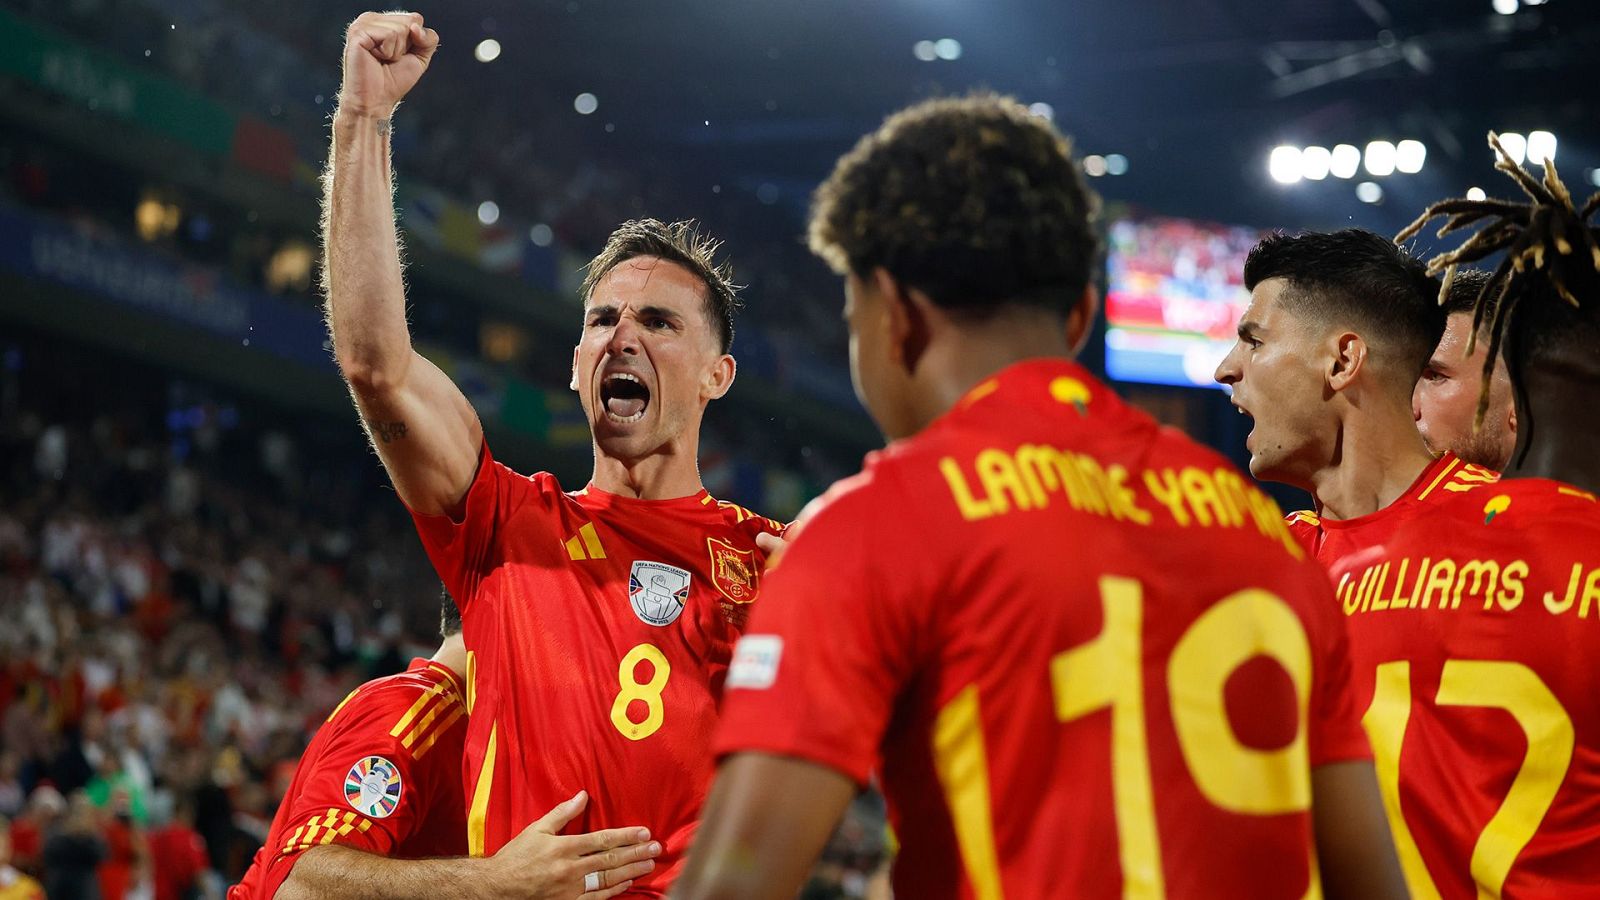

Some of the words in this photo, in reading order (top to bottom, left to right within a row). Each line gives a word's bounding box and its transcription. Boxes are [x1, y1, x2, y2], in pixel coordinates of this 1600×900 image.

[938, 443, 1152, 526] LAMINE
[1335, 557, 1529, 616] WILLIAMS
[610, 643, 671, 741] 8
[1050, 575, 1314, 900] 19
[1361, 659, 1575, 900] 17
